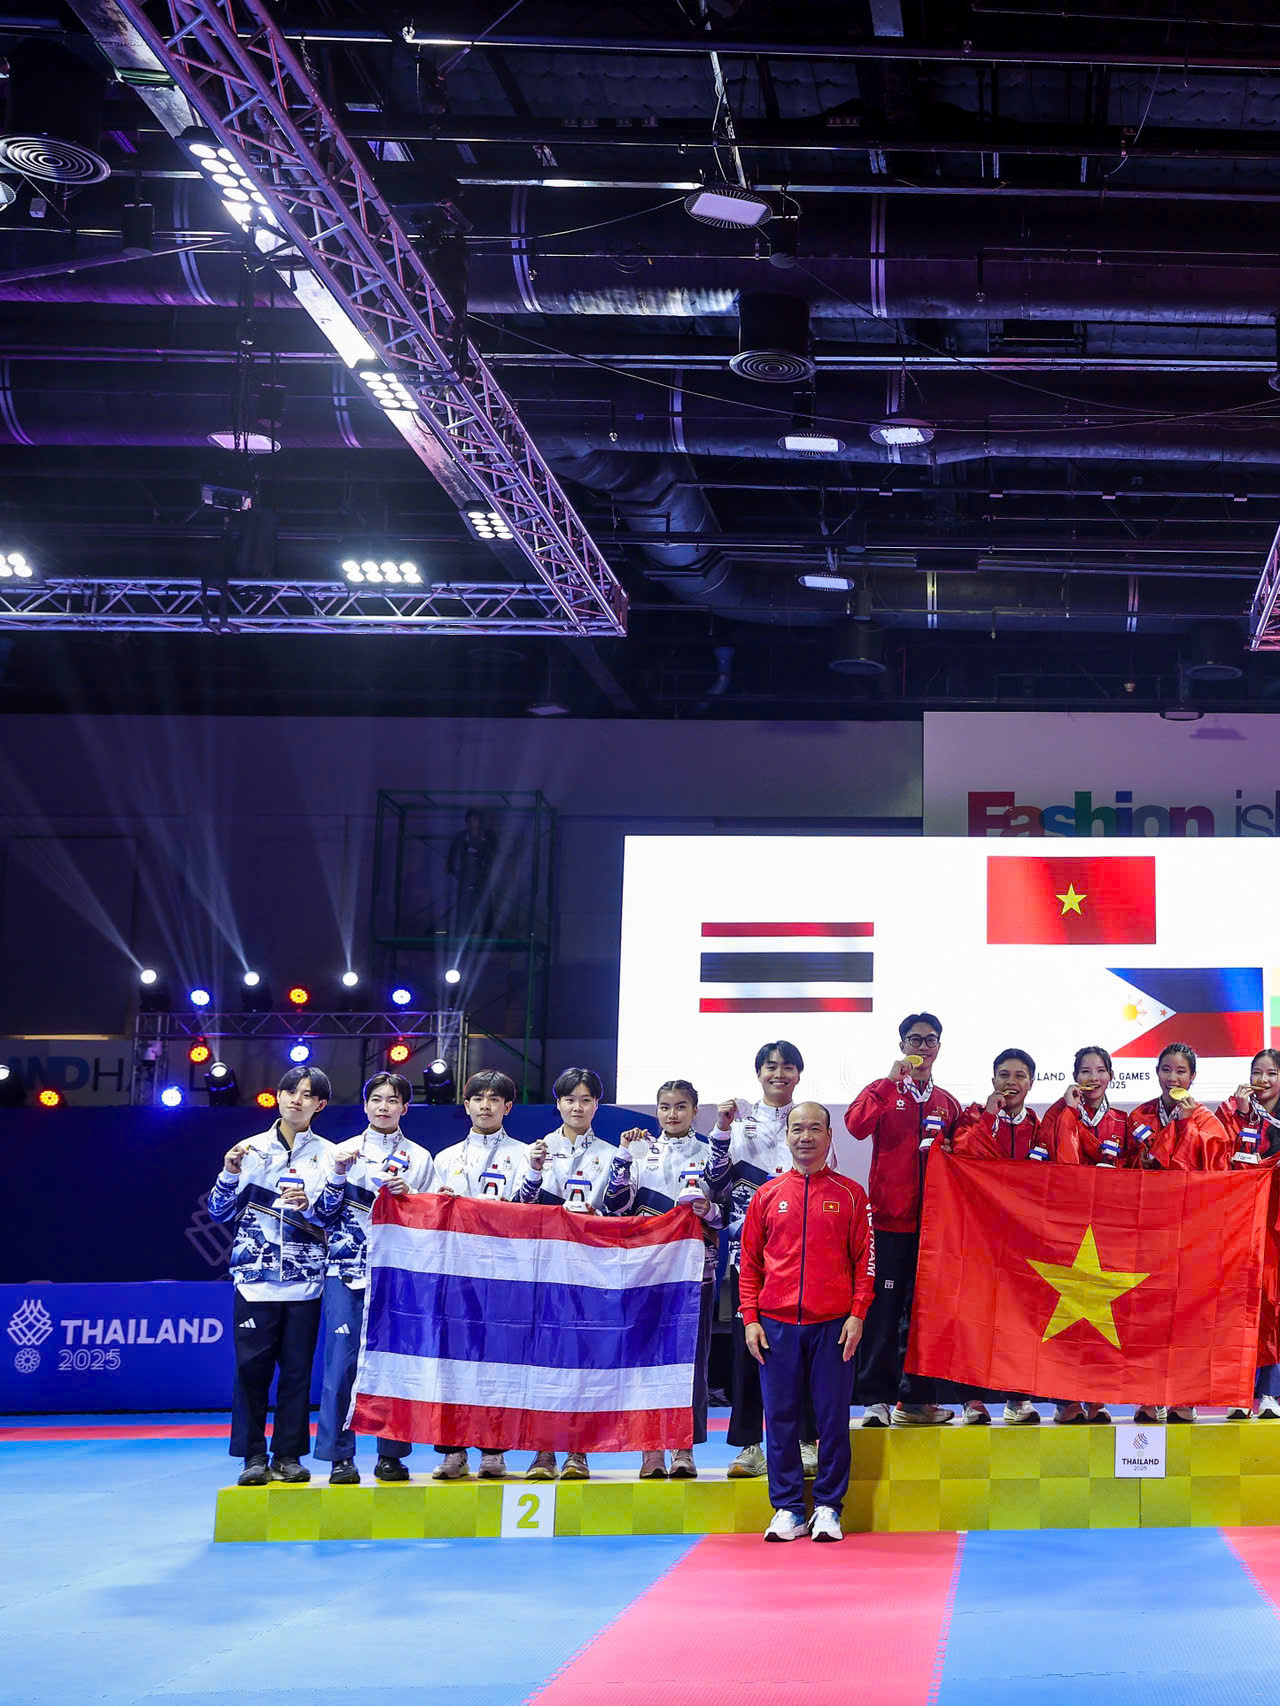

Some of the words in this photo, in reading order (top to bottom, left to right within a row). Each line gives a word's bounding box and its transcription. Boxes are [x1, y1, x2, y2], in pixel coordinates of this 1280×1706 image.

[968, 791, 1215, 837] Fashion
[1109, 1081, 1127, 1089] 025
[1119, 1072, 1151, 1081] GAMES
[60, 1318, 224, 1345] THAILAND
[57, 1348, 121, 1371] 2025
[517, 1493, 540, 1529] 2
